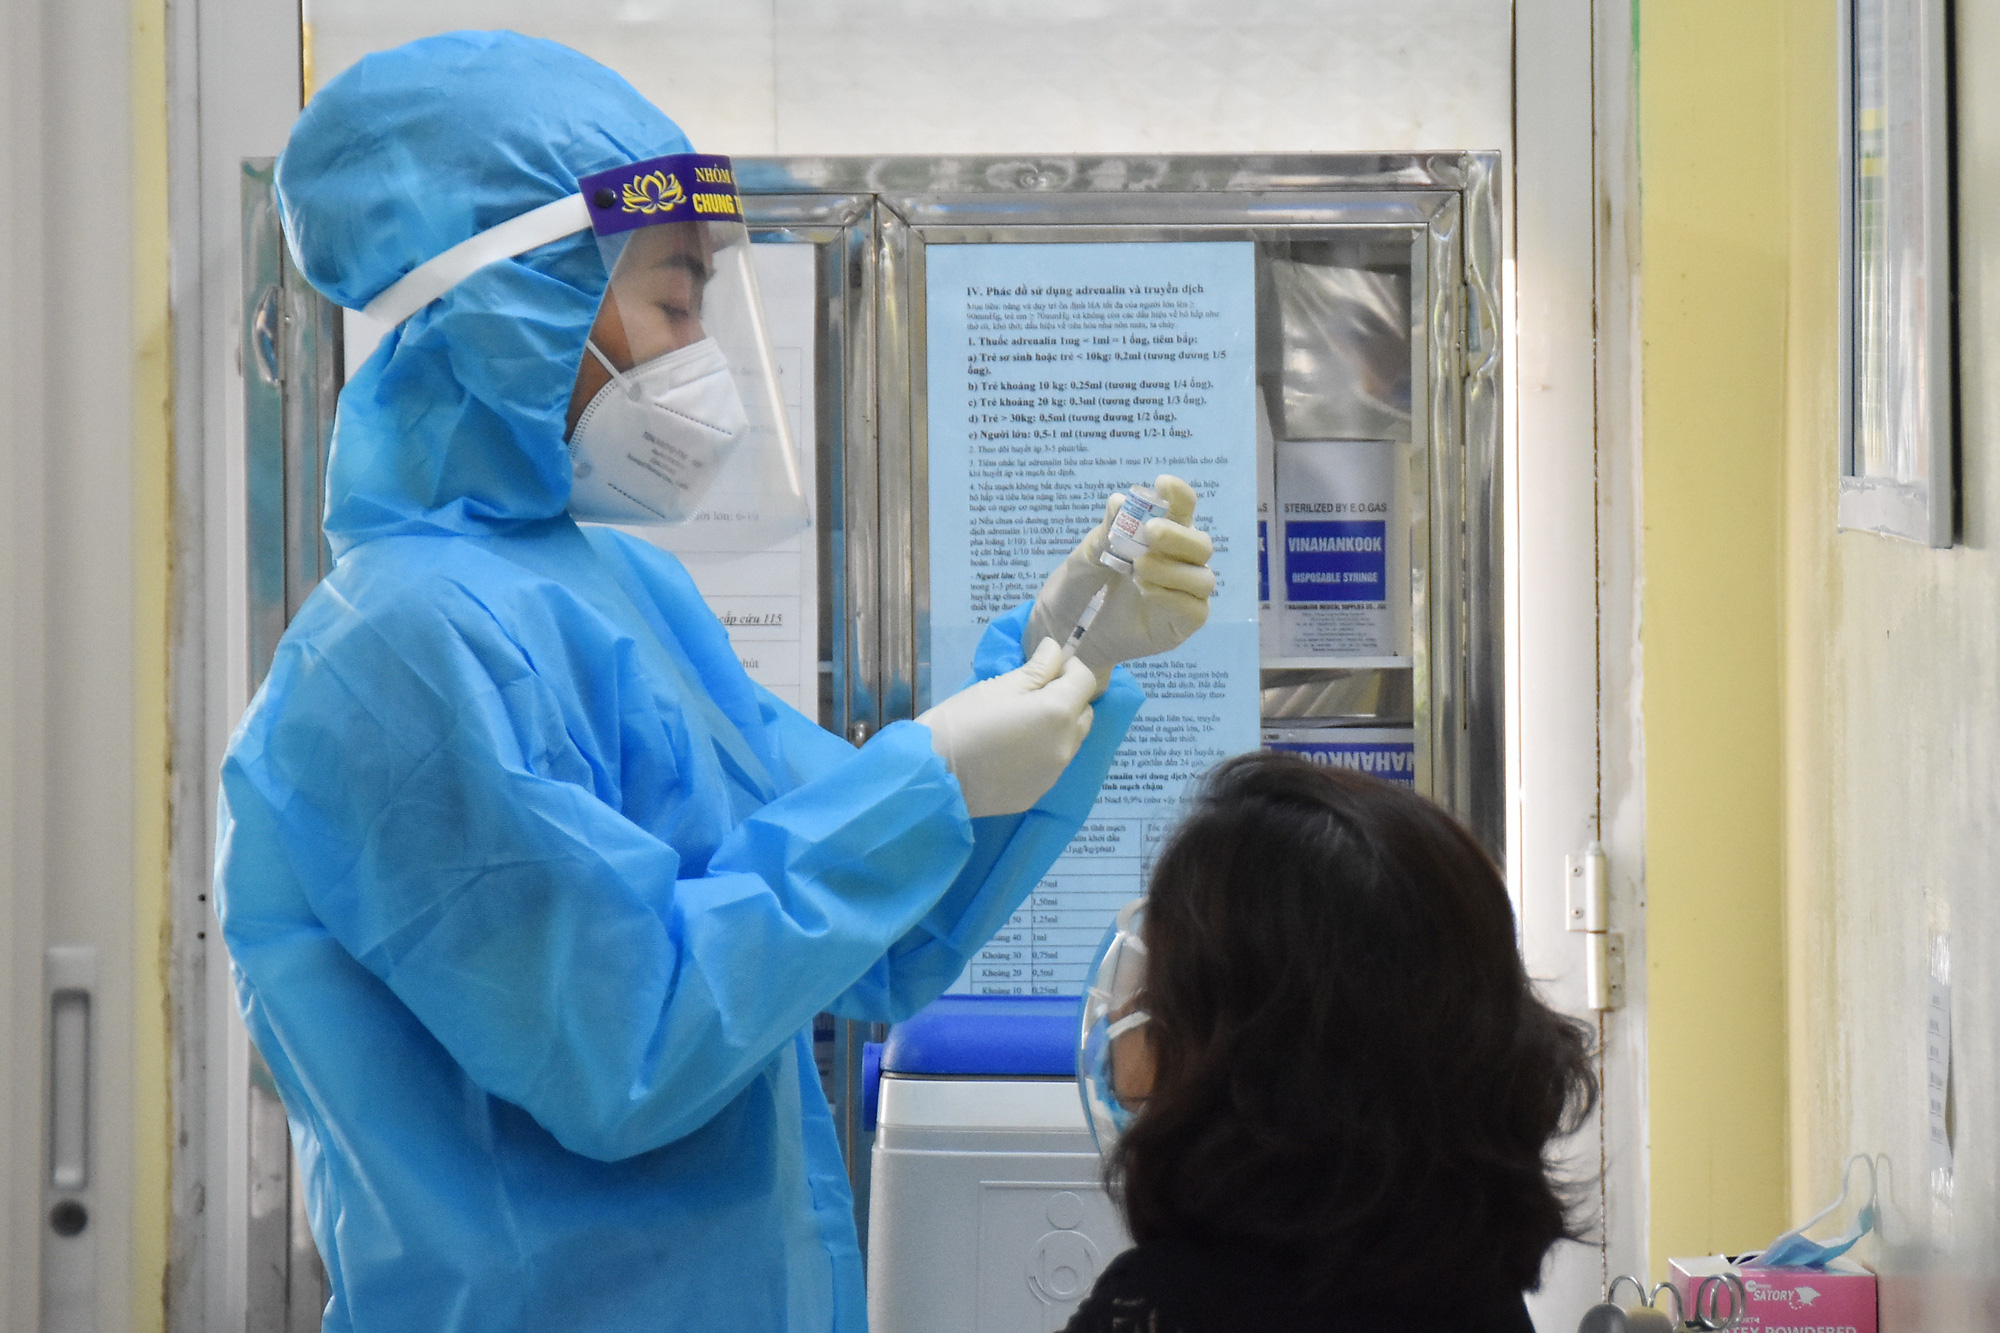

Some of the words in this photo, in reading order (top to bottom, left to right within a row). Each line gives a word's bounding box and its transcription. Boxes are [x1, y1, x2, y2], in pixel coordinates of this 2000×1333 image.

[692, 193, 736, 214] CHUNG
[1014, 286, 1028, 295] đồ
[1046, 287, 1072, 297] dụng
[1076, 286, 1125, 294] adrenalin
[1144, 285, 1178, 295] truyền
[1182, 285, 1204, 295] dịch
[1285, 503, 1333, 512] STERILIZED
[1336, 503, 1348, 512] BY
[1288, 537, 1383, 552] VINAHANKOOK
[1292, 572, 1341, 582] DISPOSABLE
[1343, 572, 1378, 582] SYRINGE
[742, 658, 759, 668] hút
[1753, 1290, 1795, 1300] SATORY
